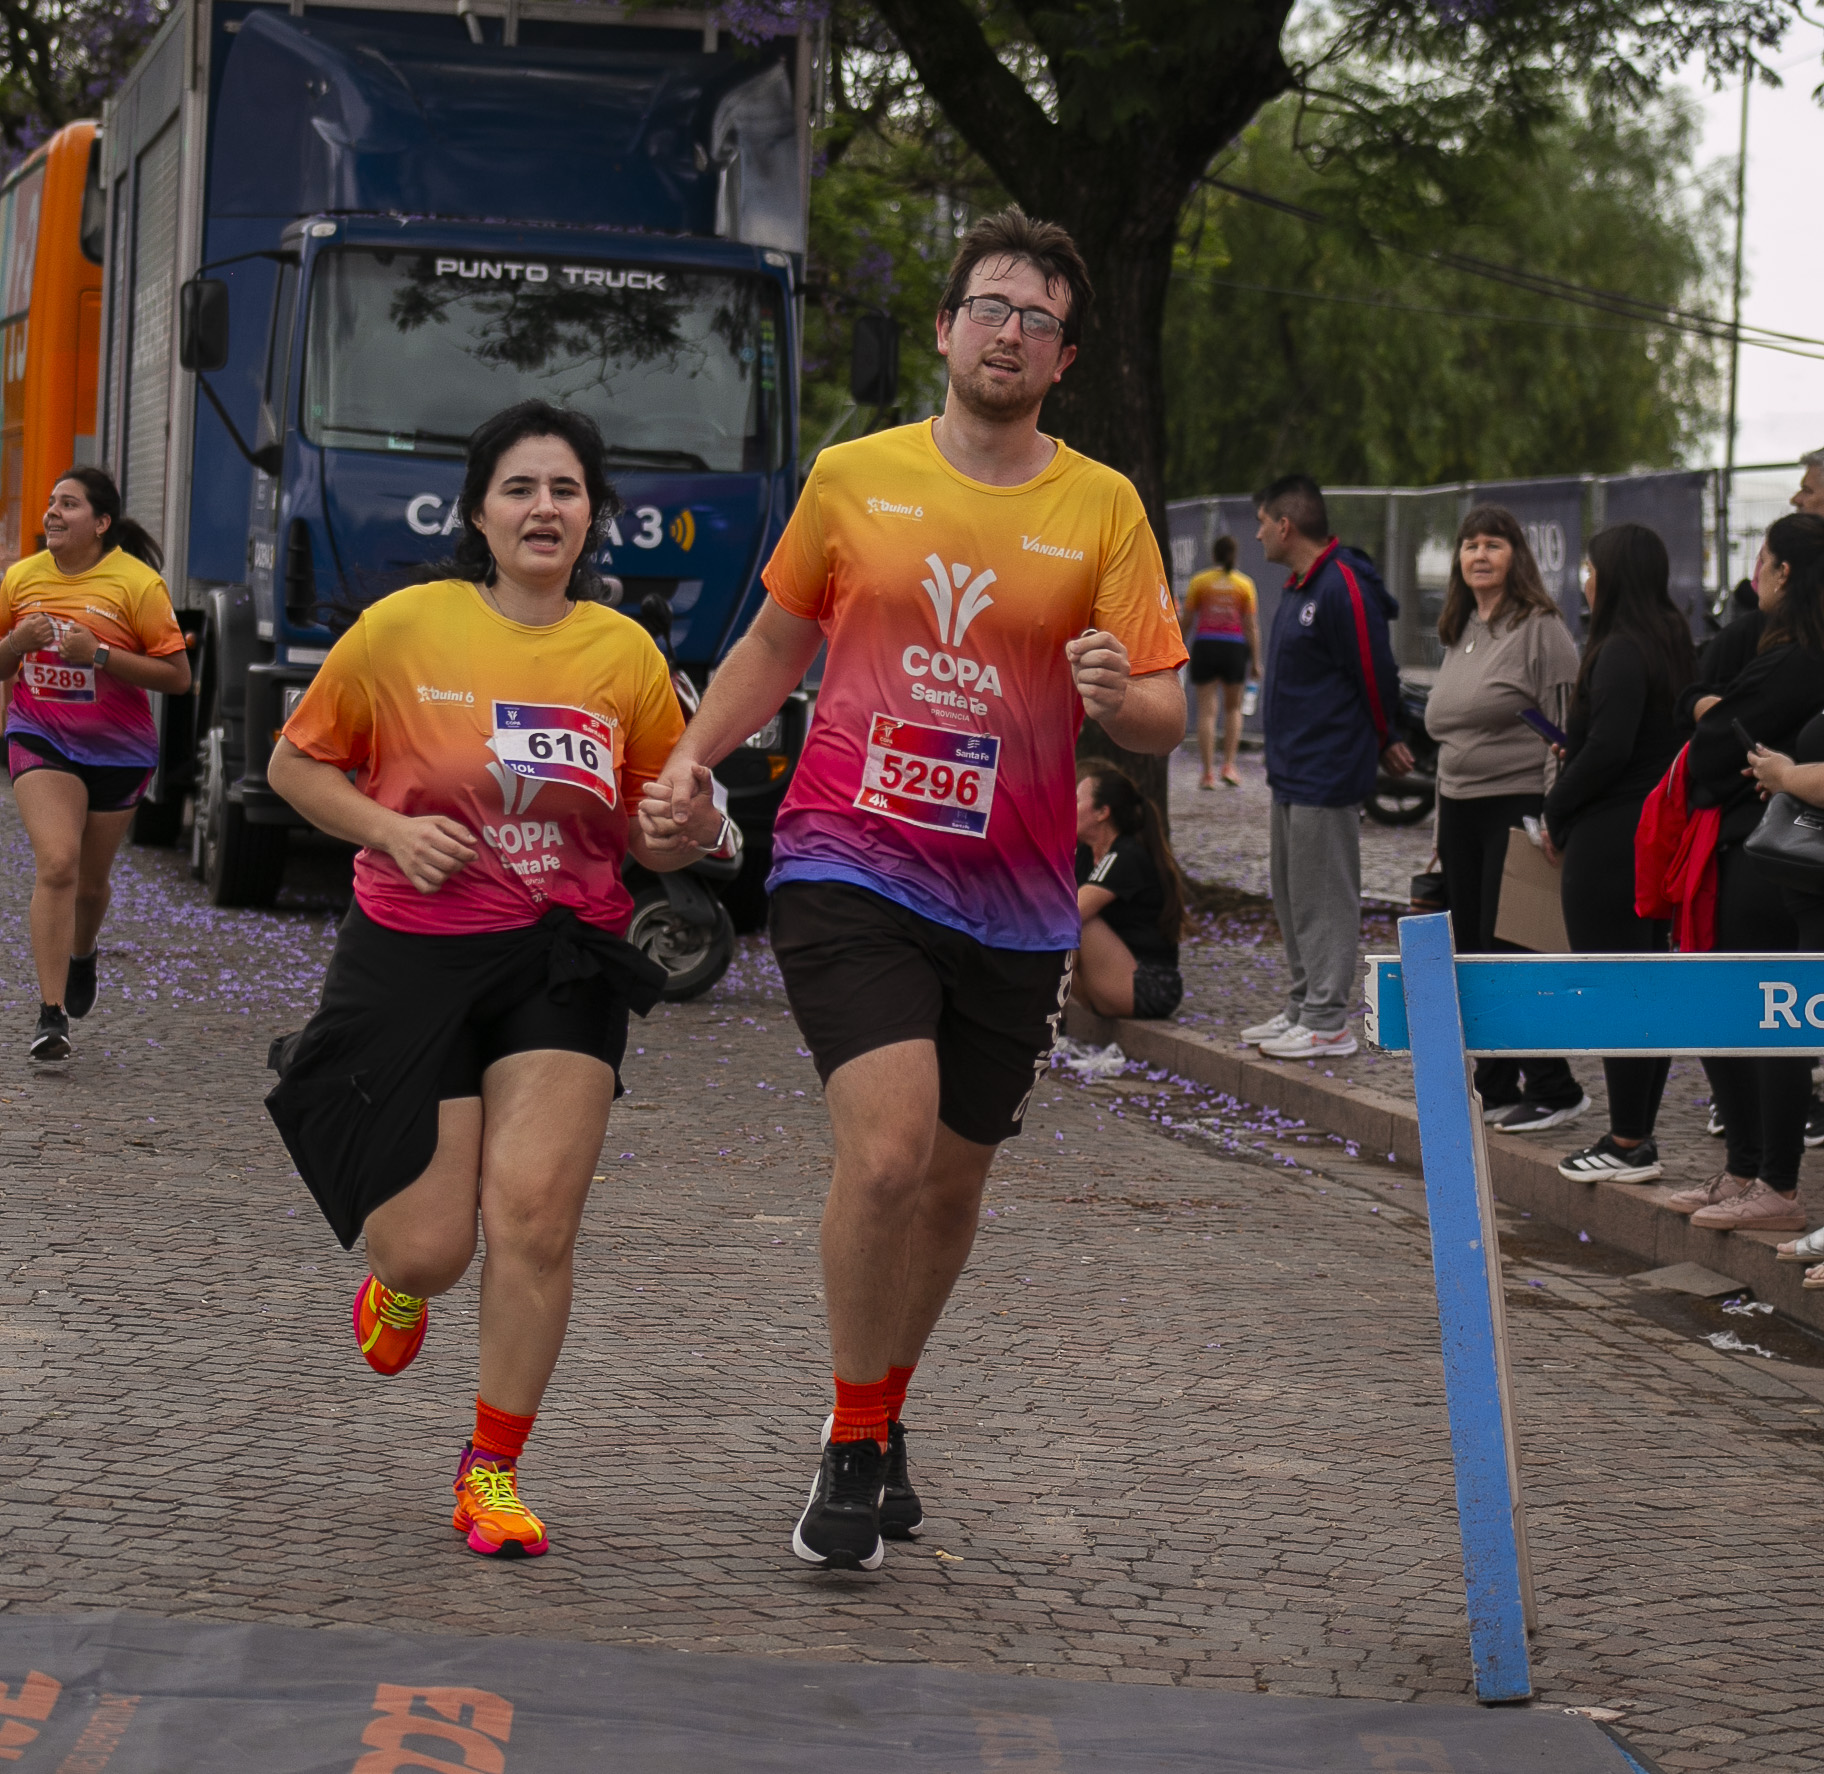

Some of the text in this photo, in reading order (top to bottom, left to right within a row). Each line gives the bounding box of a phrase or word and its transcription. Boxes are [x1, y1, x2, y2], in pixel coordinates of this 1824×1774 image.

[435, 258, 666, 291] PUNTO TRUCK
[915, 506, 924, 518] 6
[633, 506, 663, 549] 3
[1021, 535, 1084, 561] VANDALIA
[33, 667, 86, 689] 5289
[902, 645, 1003, 698] COPA
[465, 692, 475, 703] 6
[911, 683, 988, 717] Santa Fe
[931, 708, 970, 722] PROVINCIA
[528, 732, 599, 771] 616
[956, 749, 990, 761] Santa Fe
[510, 764, 536, 774] 10k
[880, 754, 981, 806] 5296
[868, 793, 888, 808] 4k
[483, 821, 564, 854] COPA
[541, 854, 561, 872] Fe
